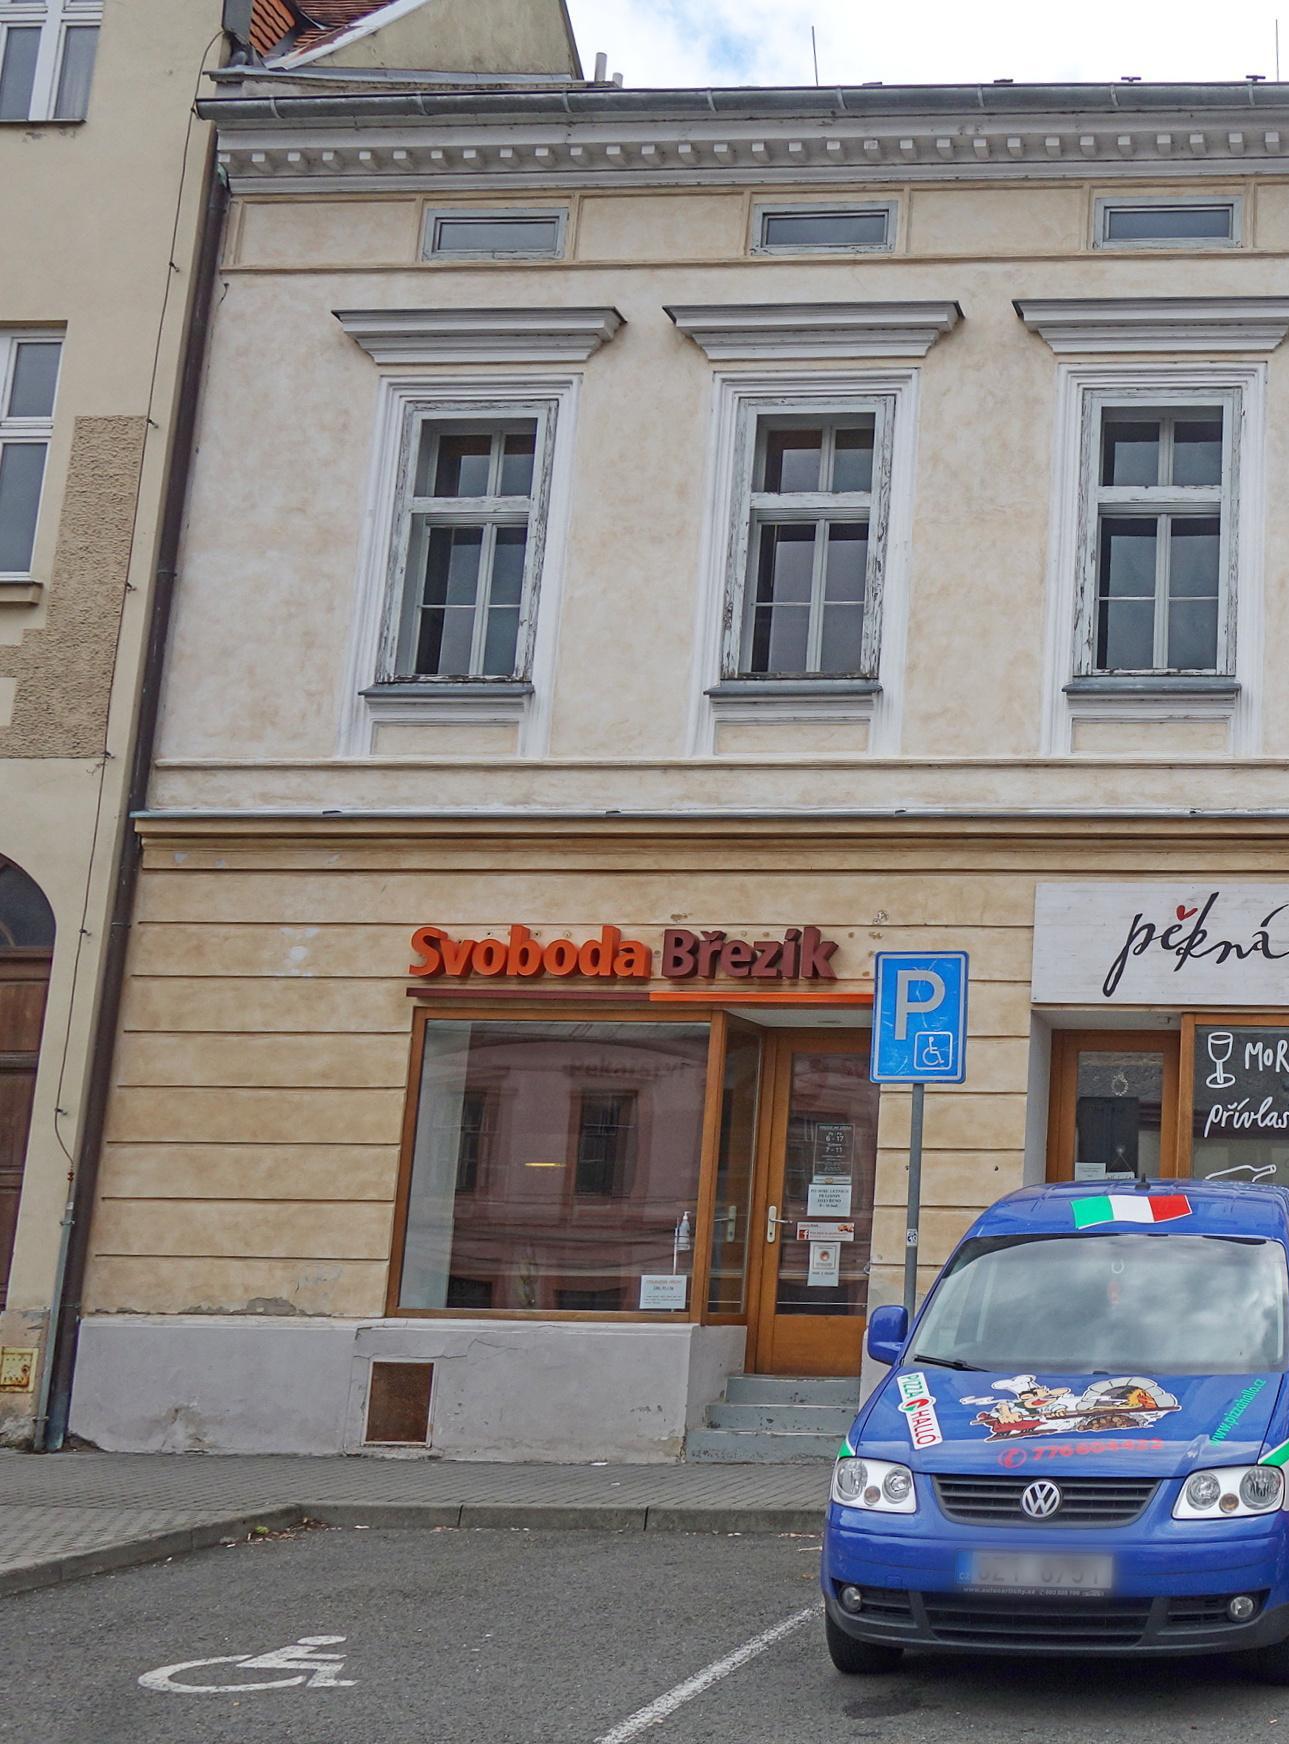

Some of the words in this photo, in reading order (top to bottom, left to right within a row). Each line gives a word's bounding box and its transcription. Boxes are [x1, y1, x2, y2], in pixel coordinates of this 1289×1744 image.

[409, 924, 652, 979] Svoboda
[661, 926, 840, 981] Březík
[895, 968, 947, 1041] P
[900, 1374, 923, 1399] PIZZA
[1208, 1379, 1266, 1447] www.pizzahallo.cz
